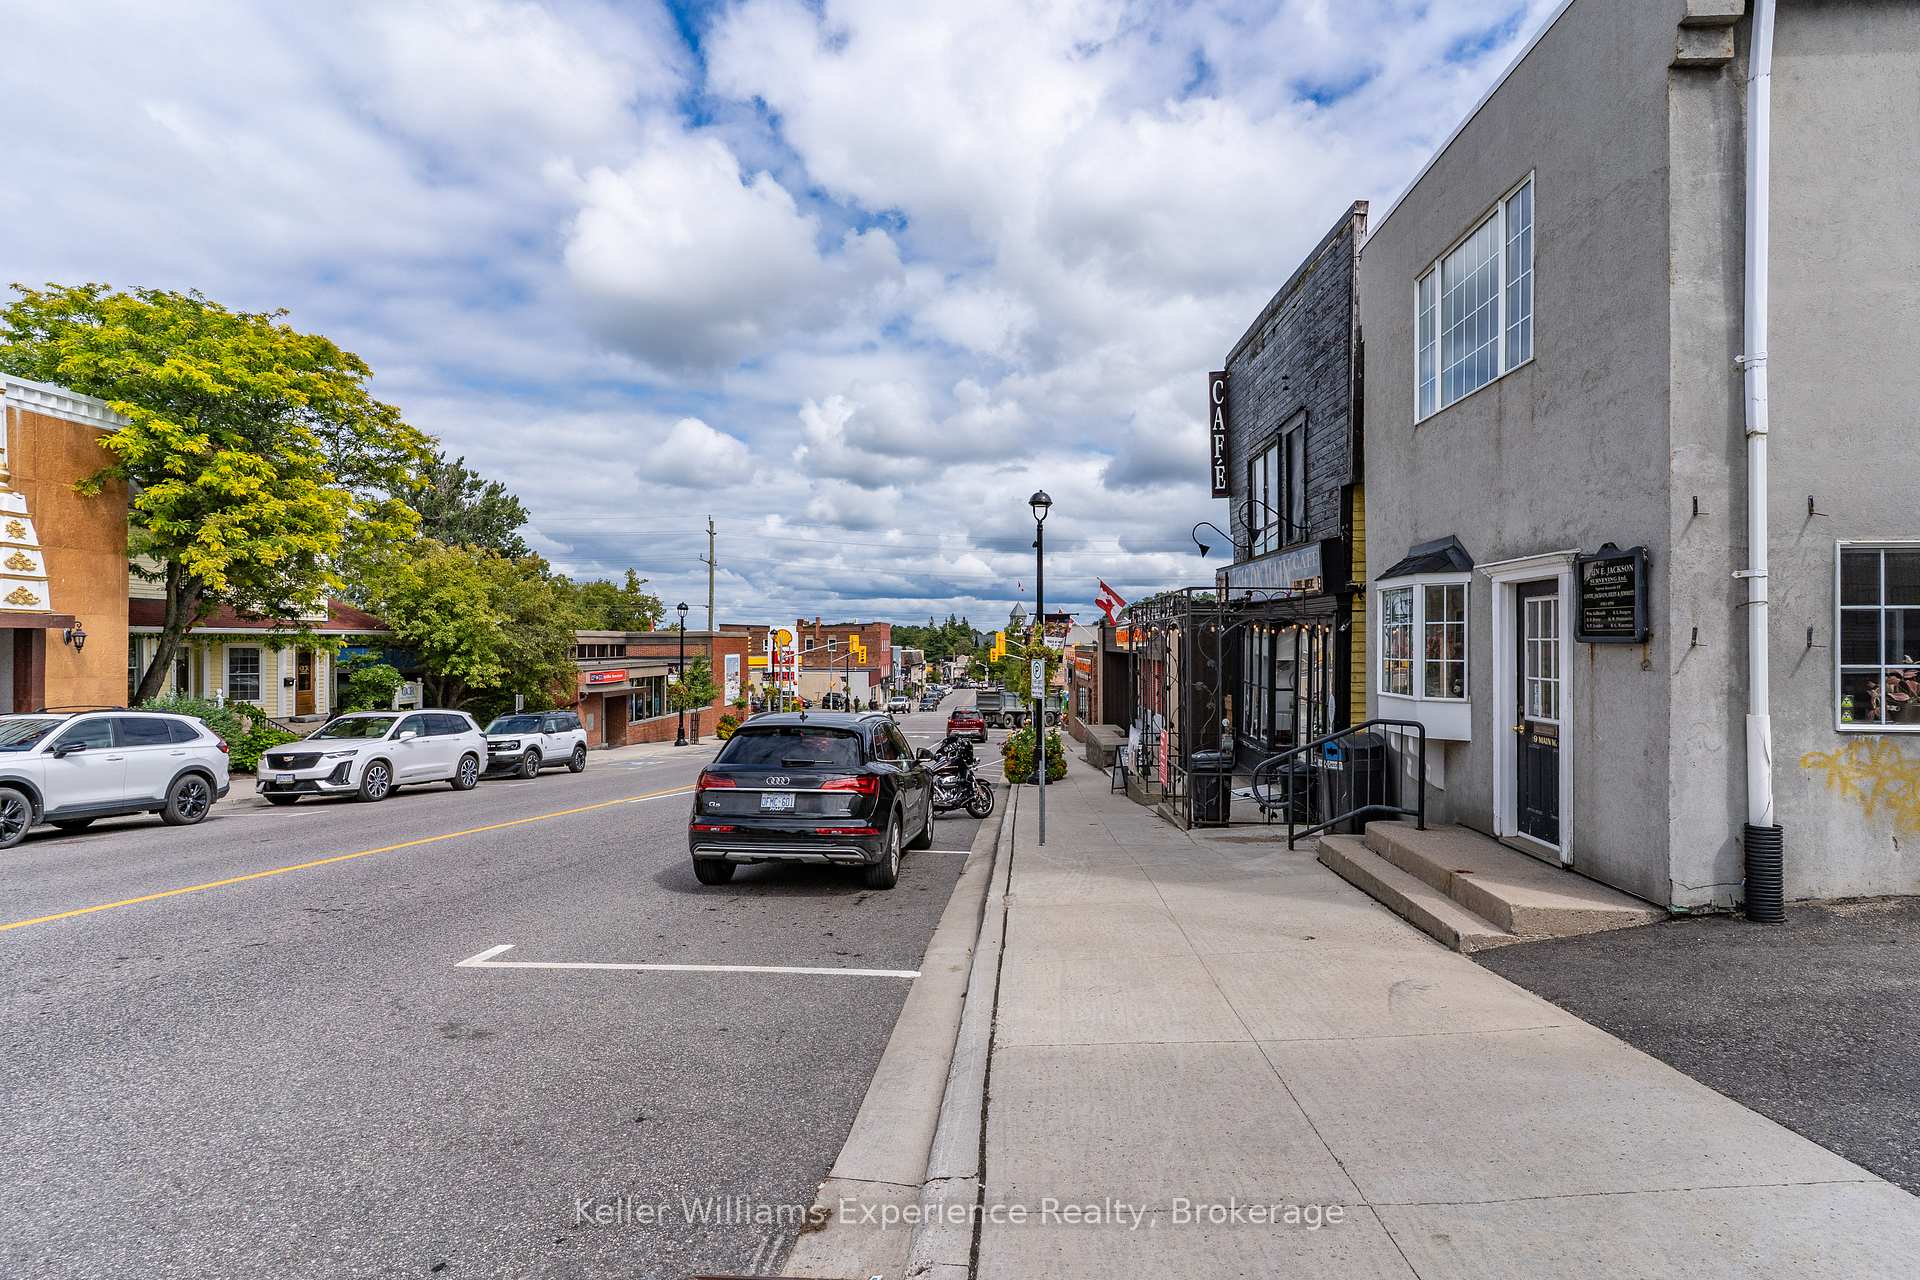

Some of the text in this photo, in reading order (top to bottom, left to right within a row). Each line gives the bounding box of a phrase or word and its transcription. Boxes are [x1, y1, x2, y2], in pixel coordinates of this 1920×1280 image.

[1212, 379, 1226, 490] CAFÉ
[1607, 564, 1634, 576] JACKSON
[1538, 736, 1552, 746] MAIN
